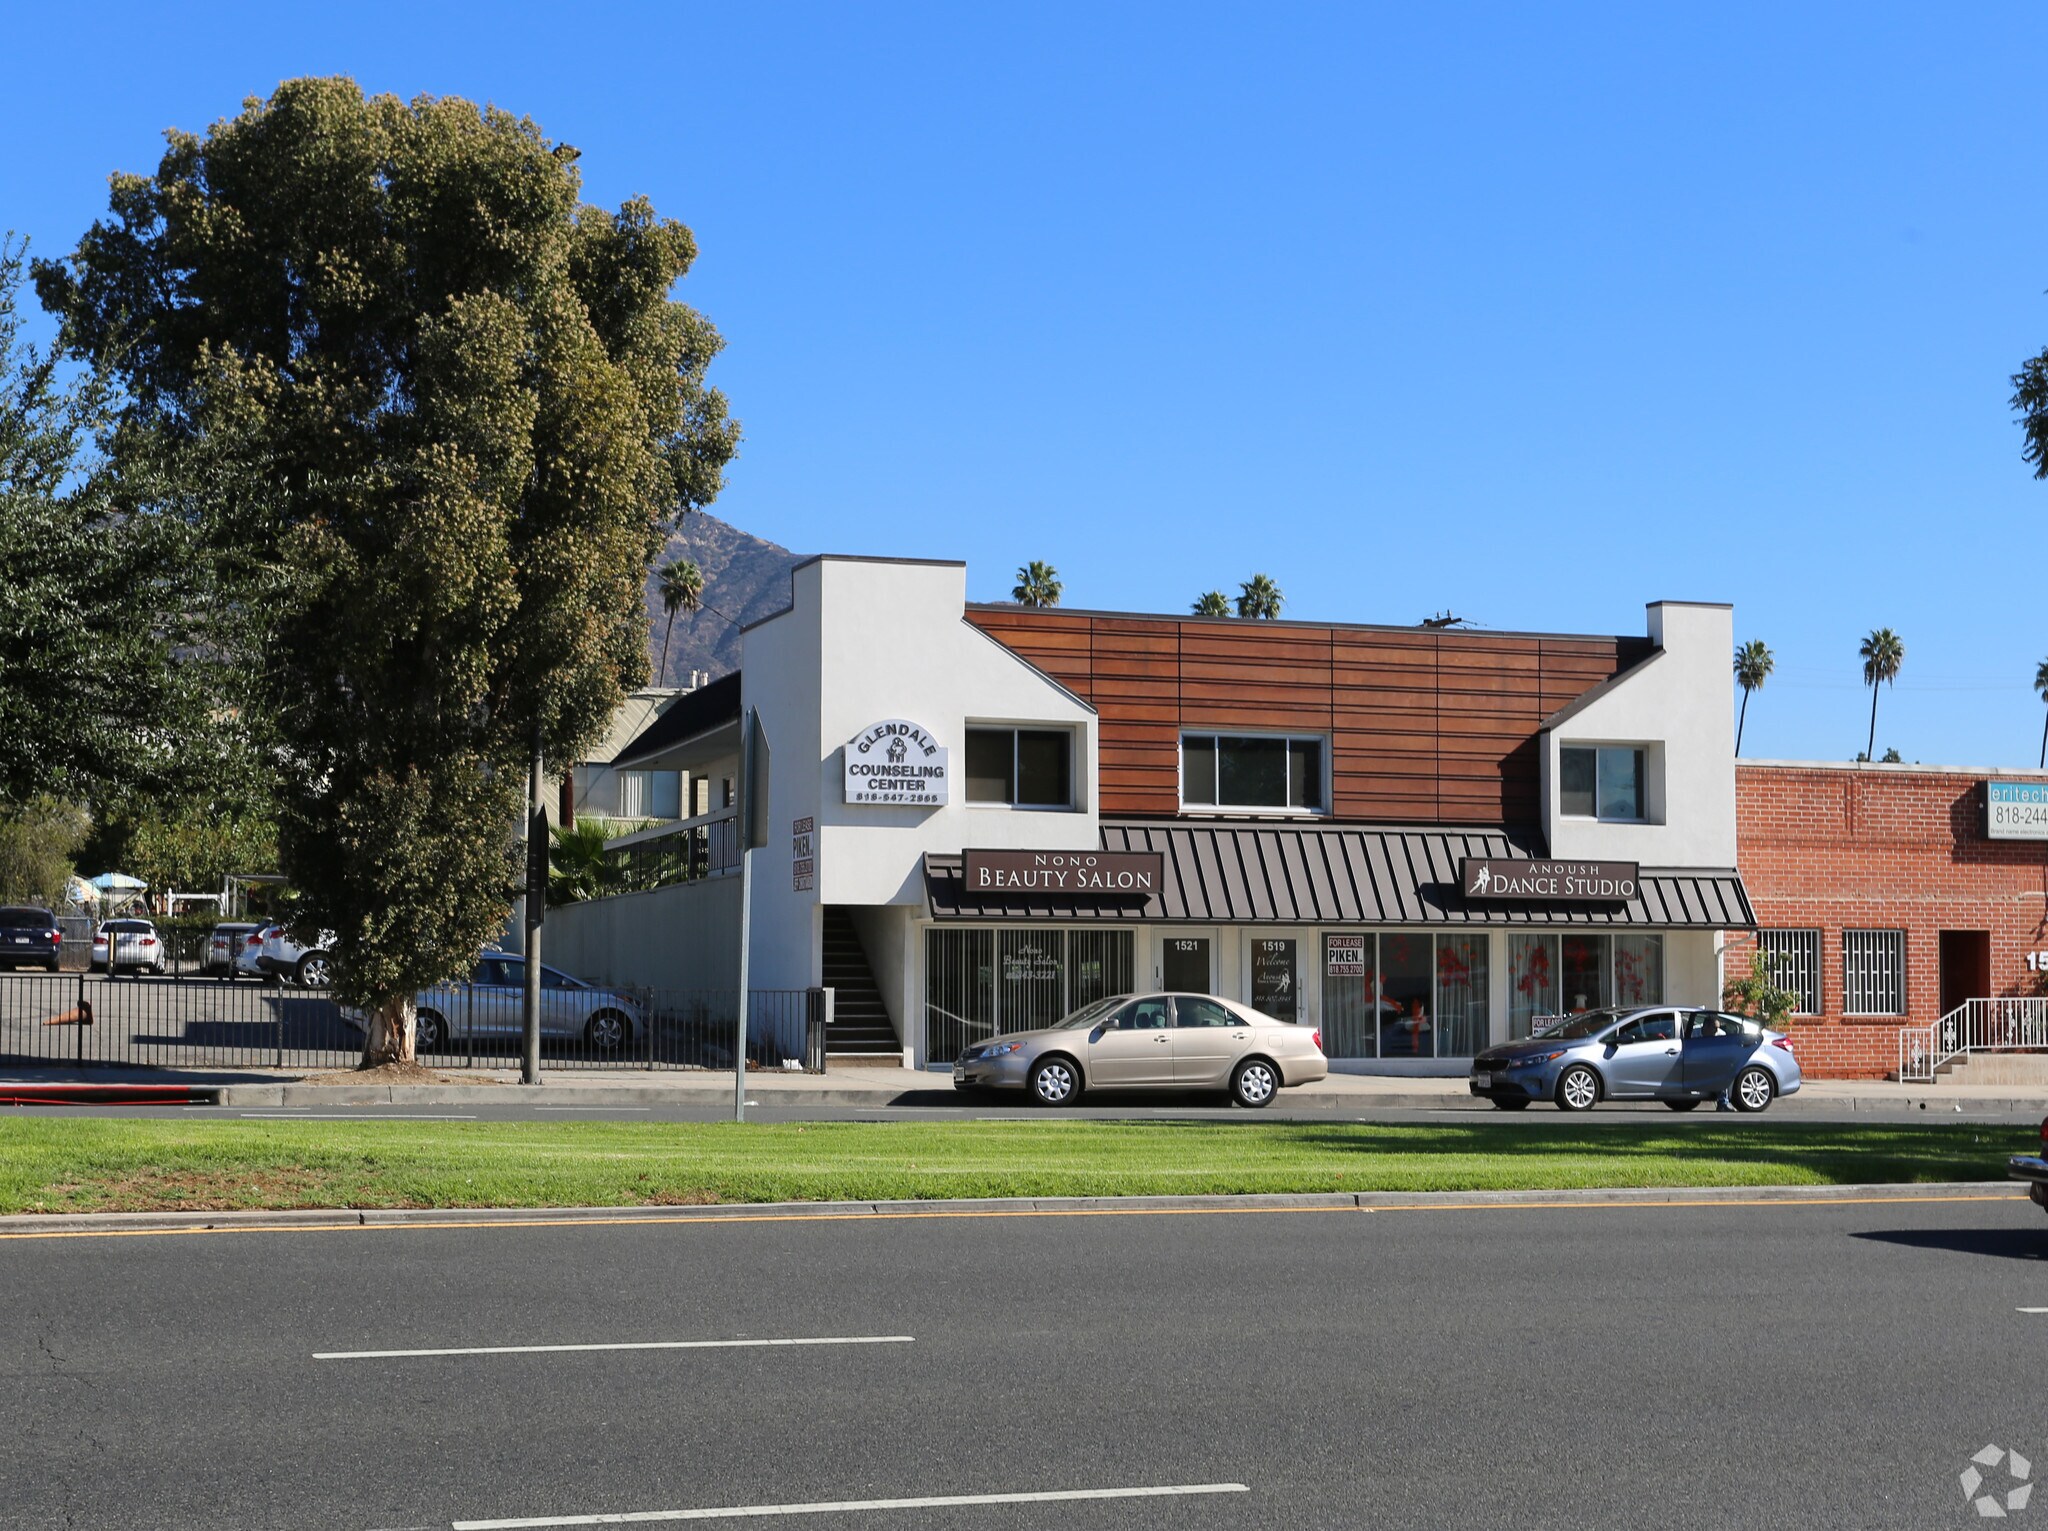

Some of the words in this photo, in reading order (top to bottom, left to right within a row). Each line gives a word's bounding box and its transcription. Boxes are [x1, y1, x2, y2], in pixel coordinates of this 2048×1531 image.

[857, 723, 937, 758] GLENDALE
[849, 764, 944, 778] COUNSELING
[868, 778, 926, 791] CENTER
[793, 834, 810, 859] PIKEN
[1035, 854, 1098, 867] NONO
[1529, 863, 1599, 875] ANOUSH
[979, 867, 1068, 888] BEAUTY
[1077, 868, 1151, 889] SALON
[1493, 875, 1558, 895] DANCE
[1565, 876, 1634, 896] STUDIO
[1175, 940, 1198, 951] 1521
[1262, 941, 1285, 951] 1519
[1330, 939, 1342, 947] FOR
[1343, 939, 1361, 947] LEASE
[1003, 955, 1031, 969] Beauty
[1034, 955, 1057, 965] Salon
[1329, 950, 1358, 962] PIKEN
[2026, 951, 2048, 971] 15
[1533, 1018, 1544, 1027] FOR
